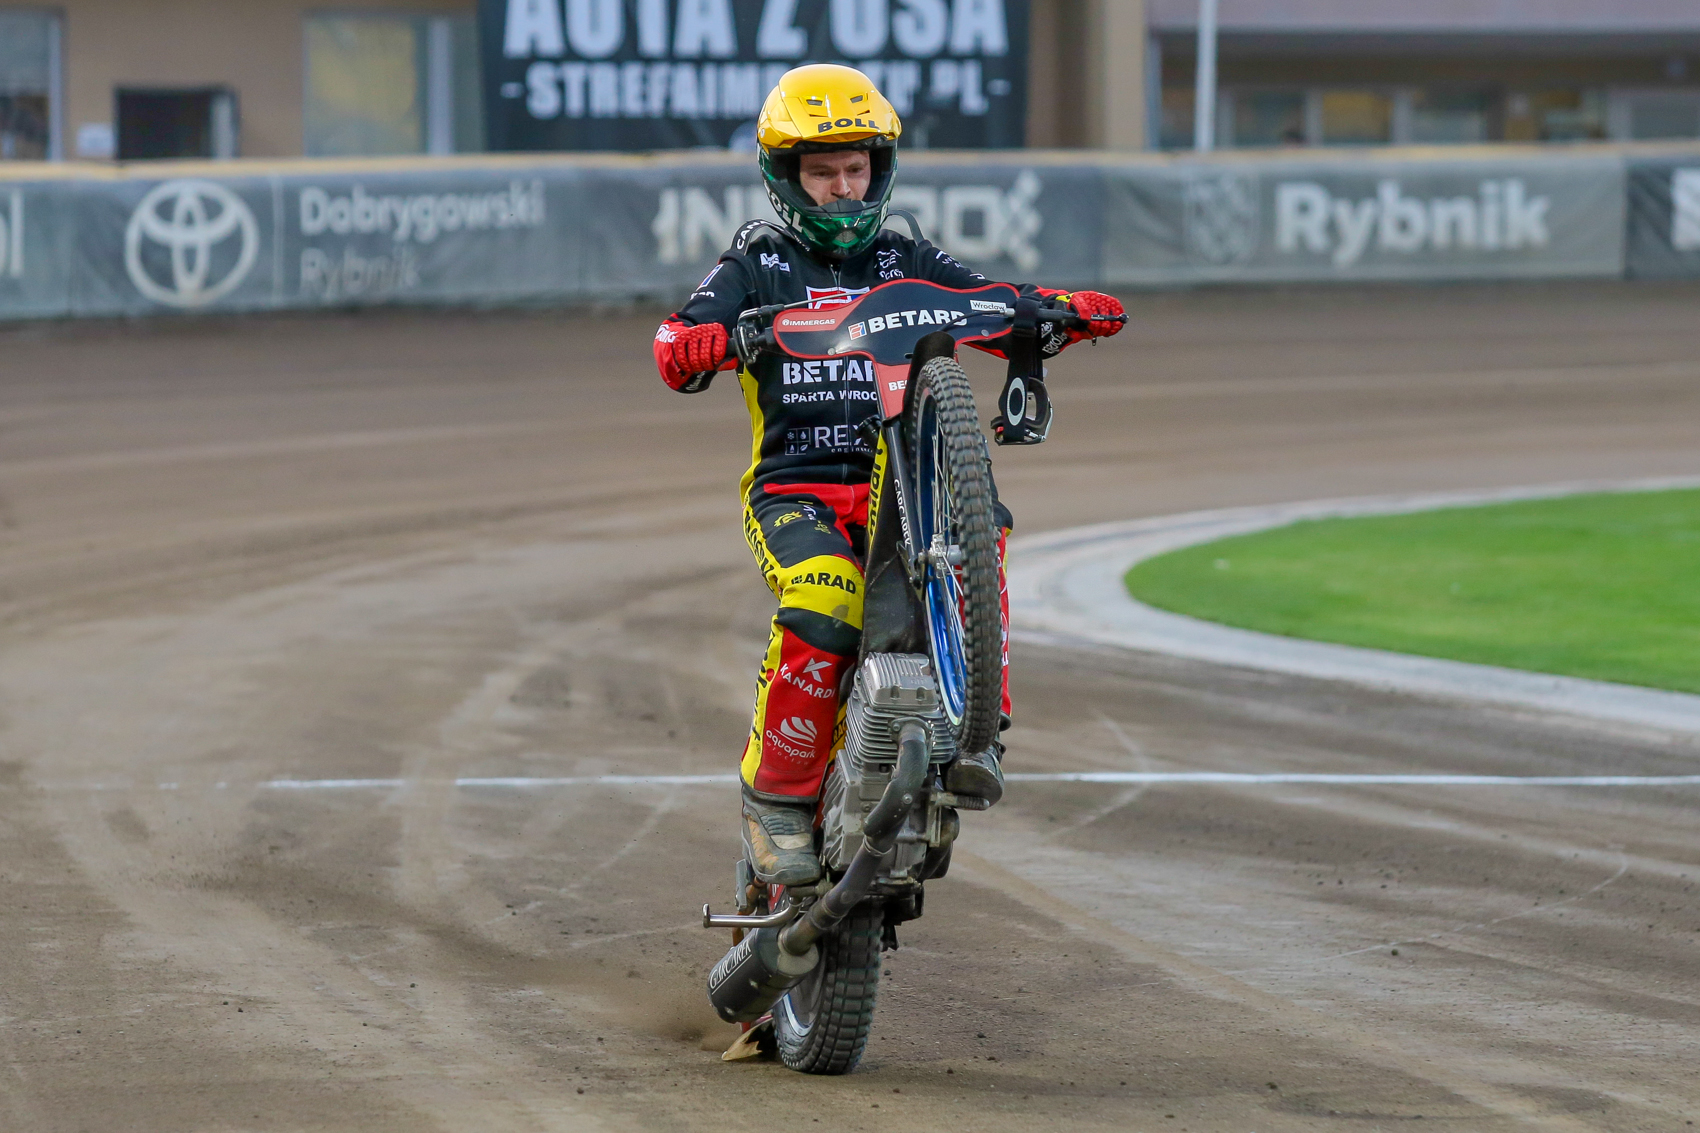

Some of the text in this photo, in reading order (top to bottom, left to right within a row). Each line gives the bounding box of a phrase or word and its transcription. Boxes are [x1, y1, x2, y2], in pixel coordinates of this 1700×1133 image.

[502, 0, 1009, 58] AUTA Z USA
[818, 118, 880, 133] BOLL
[301, 180, 546, 241] Dobrygowski
[1275, 179, 1549, 269] Rybnik
[868, 309, 967, 334] BETARD
[782, 391, 835, 404] SPARTA
[765, 729, 816, 758] aquapark
